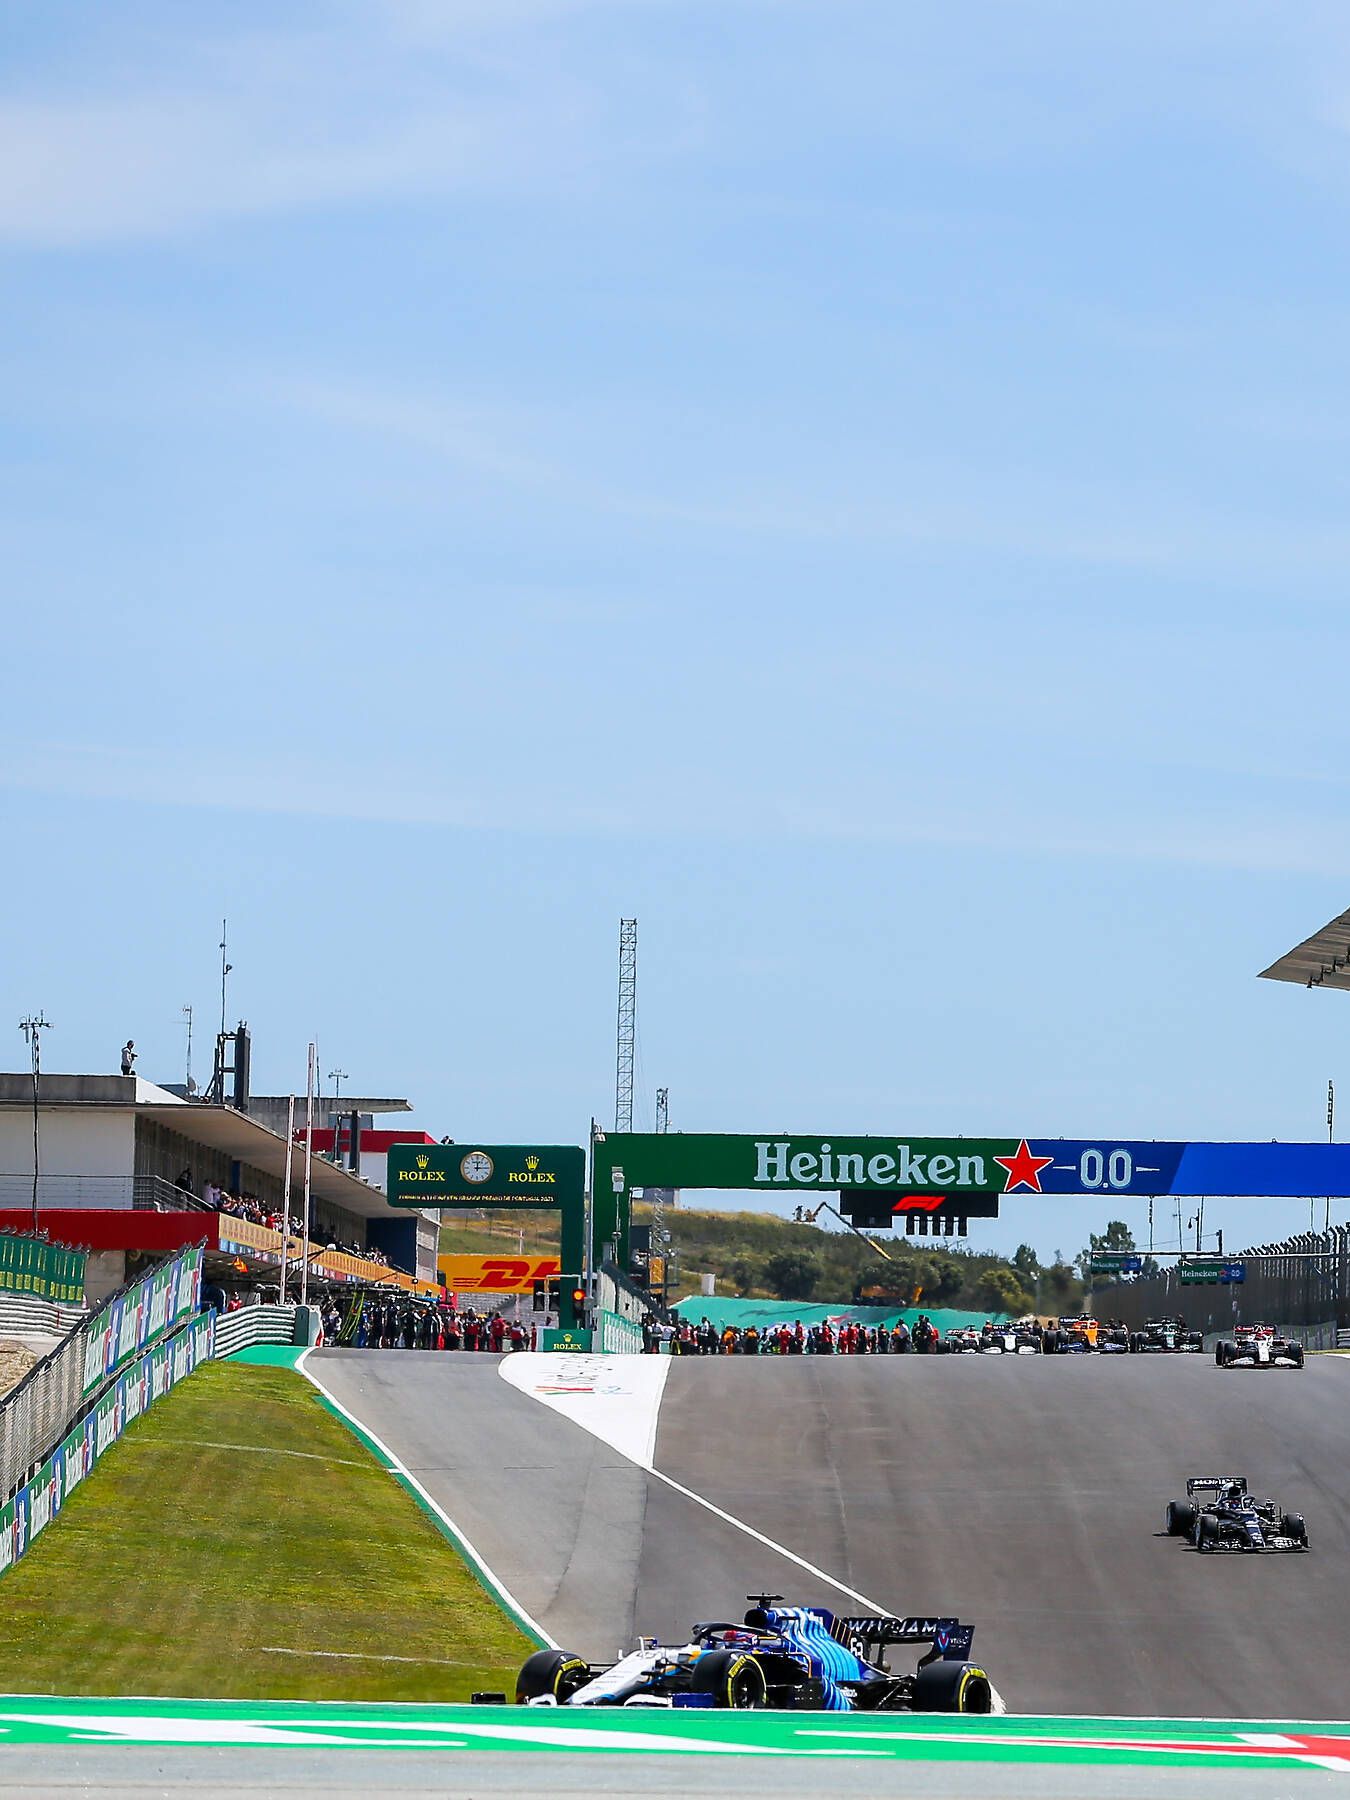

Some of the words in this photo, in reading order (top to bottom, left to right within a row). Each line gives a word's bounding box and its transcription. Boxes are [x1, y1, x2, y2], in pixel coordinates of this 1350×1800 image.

[753, 1142, 988, 1186] Heineken
[1079, 1148, 1132, 1189] 0.0
[398, 1171, 446, 1182] ROLEX
[508, 1172, 556, 1183] ROLEX
[553, 1342, 582, 1350] ROLEX
